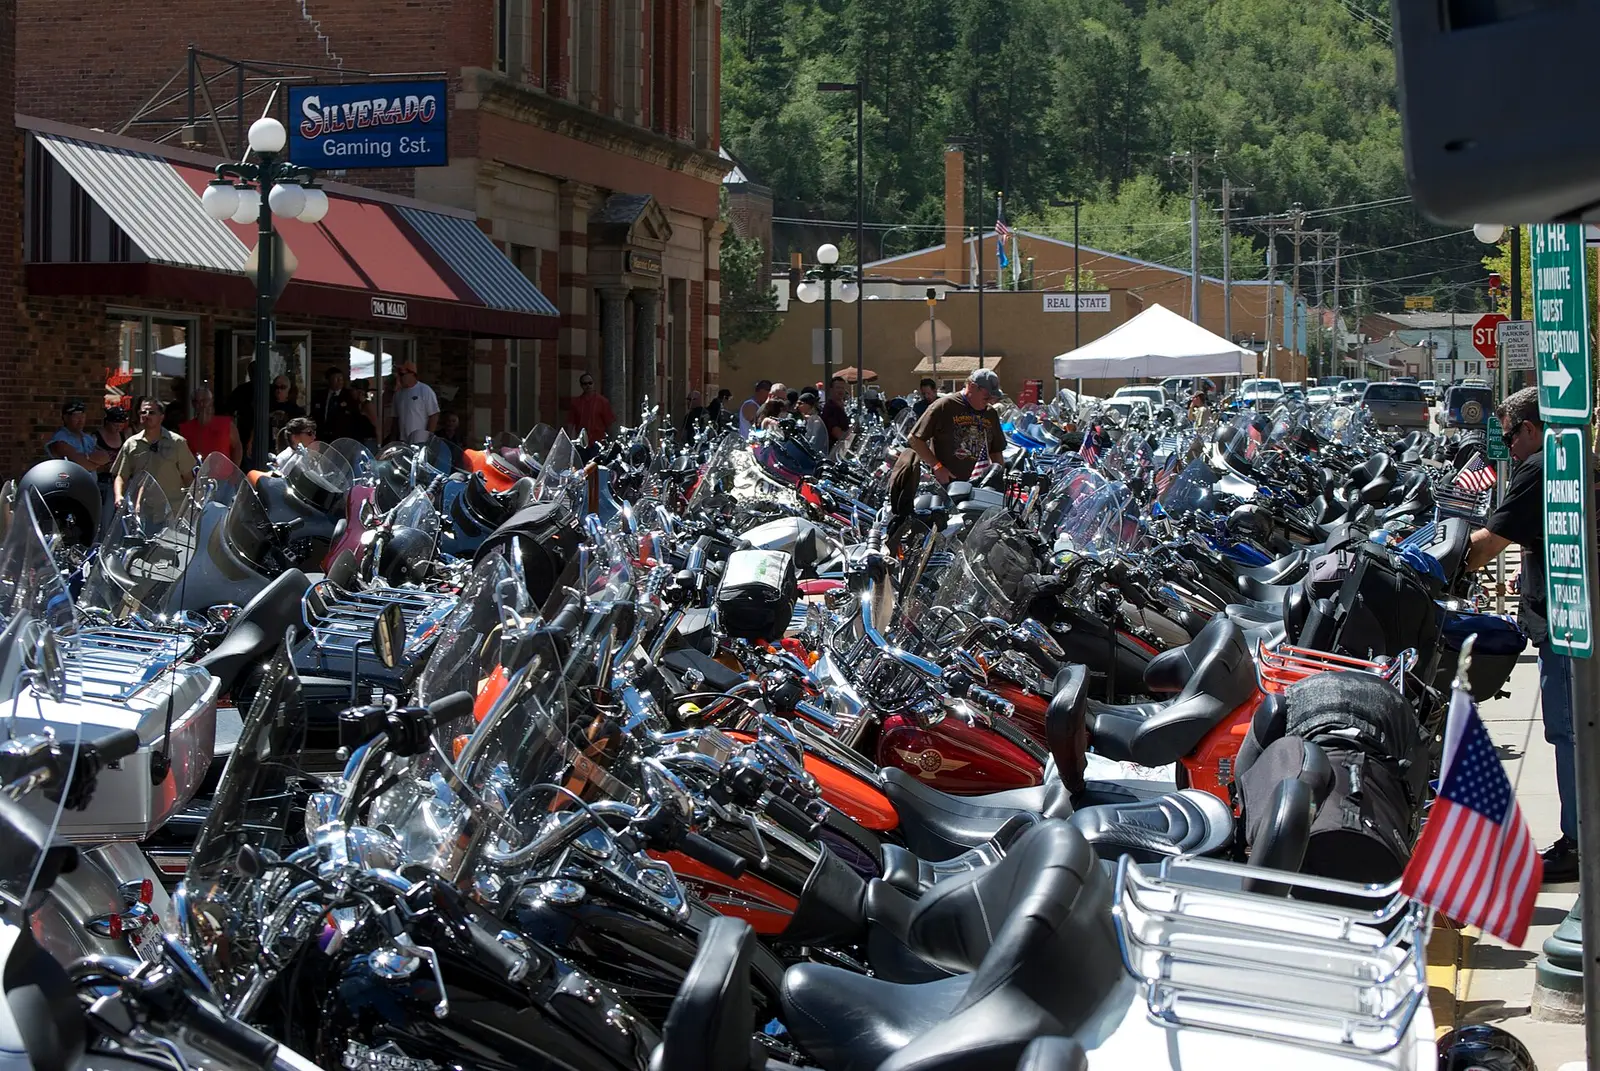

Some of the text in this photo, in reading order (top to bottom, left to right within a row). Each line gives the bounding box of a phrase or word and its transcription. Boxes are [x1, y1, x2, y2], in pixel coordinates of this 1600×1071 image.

[300, 95, 436, 139] SILVERADO
[323, 136, 431, 158] Gaming Est.
[1547, 224, 1570, 252] HR.
[1543, 266, 1571, 290] MINUTE
[386, 302, 406, 317] MAIN
[1047, 298, 1071, 308] REAL
[1542, 298, 1563, 322] GUEST
[1475, 327, 1498, 345] ST
[1556, 446, 1566, 471] NO
[1547, 479, 1579, 503] PARKING
[1548, 511, 1579, 535] HERE TO
[1550, 542, 1581, 568] CORNER
[1554, 583, 1580, 604] TROLLEY
[1568, 610, 1586, 630] ONLY
